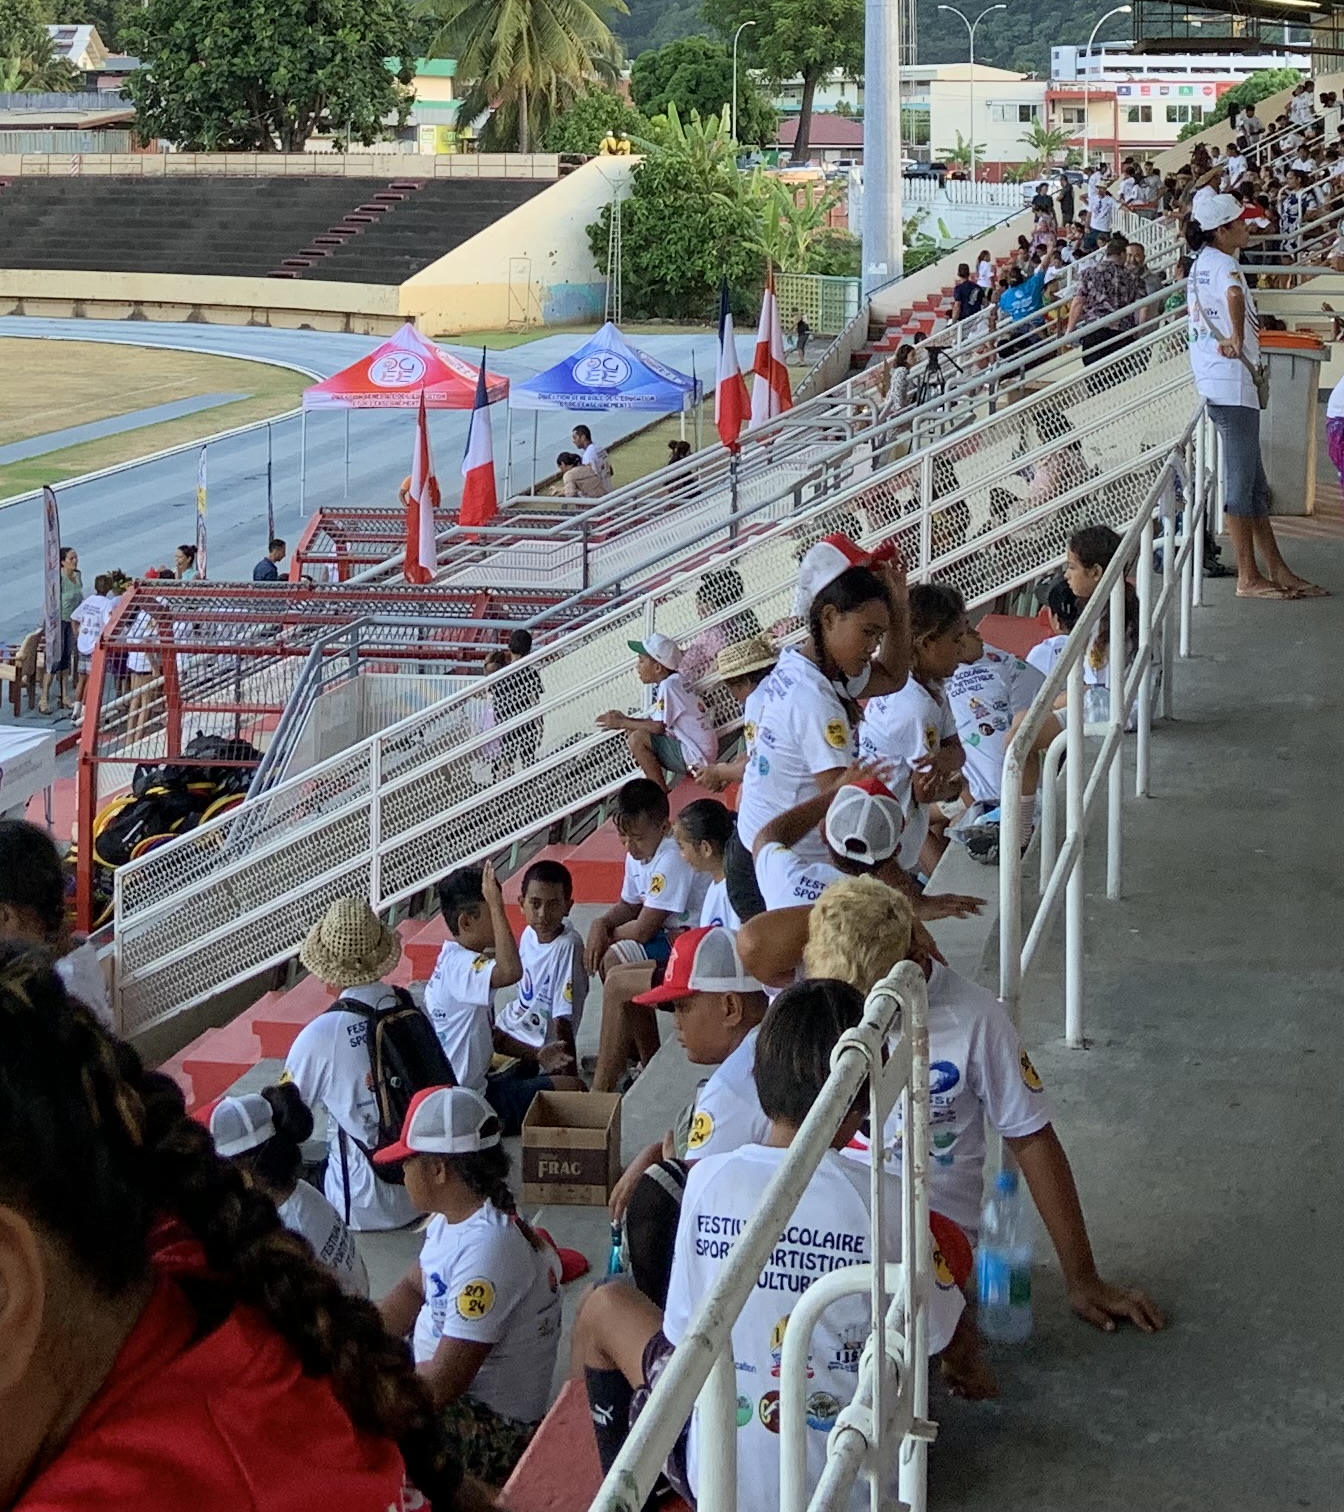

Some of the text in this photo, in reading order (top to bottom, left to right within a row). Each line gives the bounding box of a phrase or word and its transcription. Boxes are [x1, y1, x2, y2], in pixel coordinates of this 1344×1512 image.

[538, 1160, 582, 1178] FRAC
[697, 1215, 747, 1236] FESTIV
[696, 1239, 734, 1259] SPOR
[464, 1284, 485, 1298] 20
[469, 1299, 486, 1314] 24
